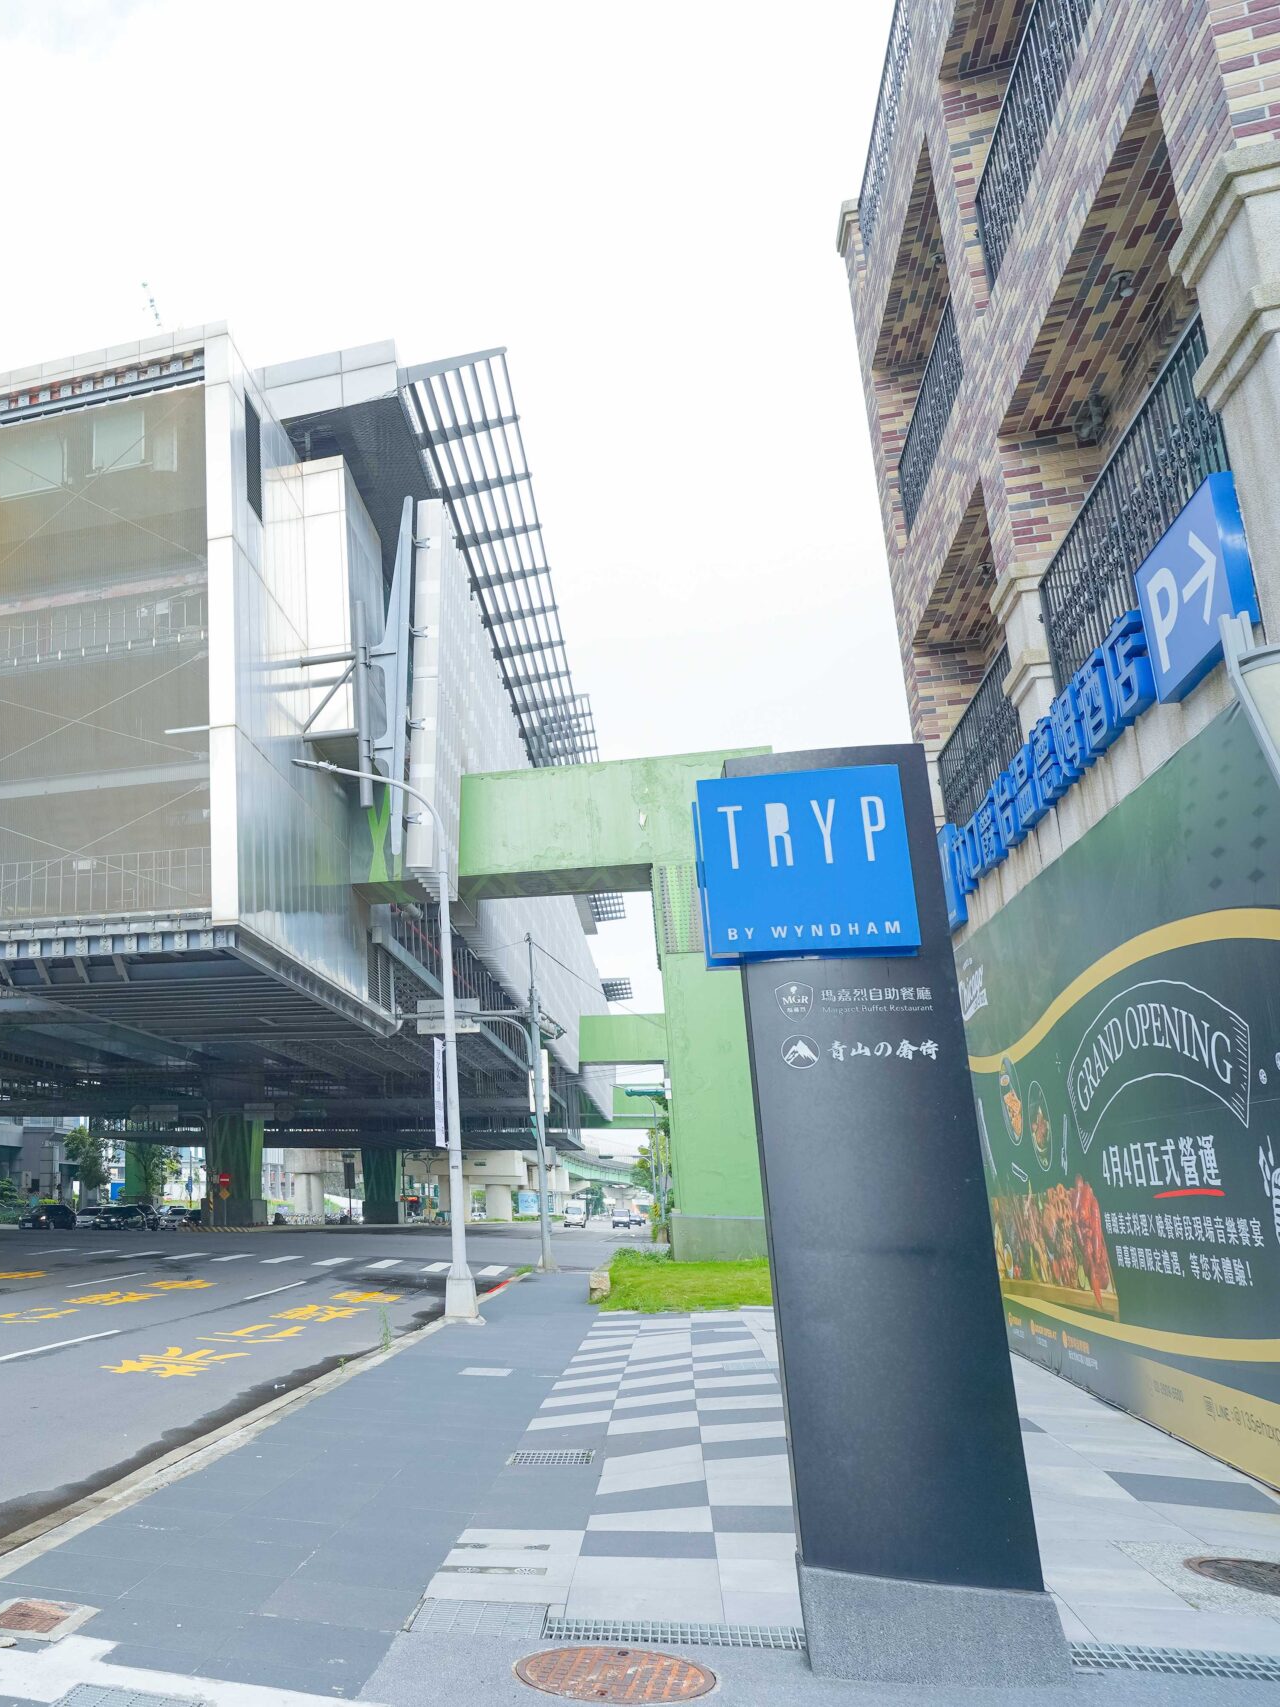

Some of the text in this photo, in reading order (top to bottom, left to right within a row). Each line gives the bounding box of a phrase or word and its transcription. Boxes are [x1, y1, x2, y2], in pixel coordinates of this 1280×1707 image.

[1147, 567, 1179, 674] P
[717, 795, 887, 870] TRYP
[728, 919, 903, 941] BY WYNDHAM
[782, 995, 809, 1005] MGR
[821, 986, 932, 1003] 瑪嘉烈自助餐廳
[861, 1004, 887, 1013] Buffet
[889, 1003, 933, 1012] Restaurant
[1076, 1002, 1234, 1114] GRAND OPENING
[1102, 1134, 1222, 1188] 4月4日正式營運
[1216, 1405, 1232, 1423] LINE
